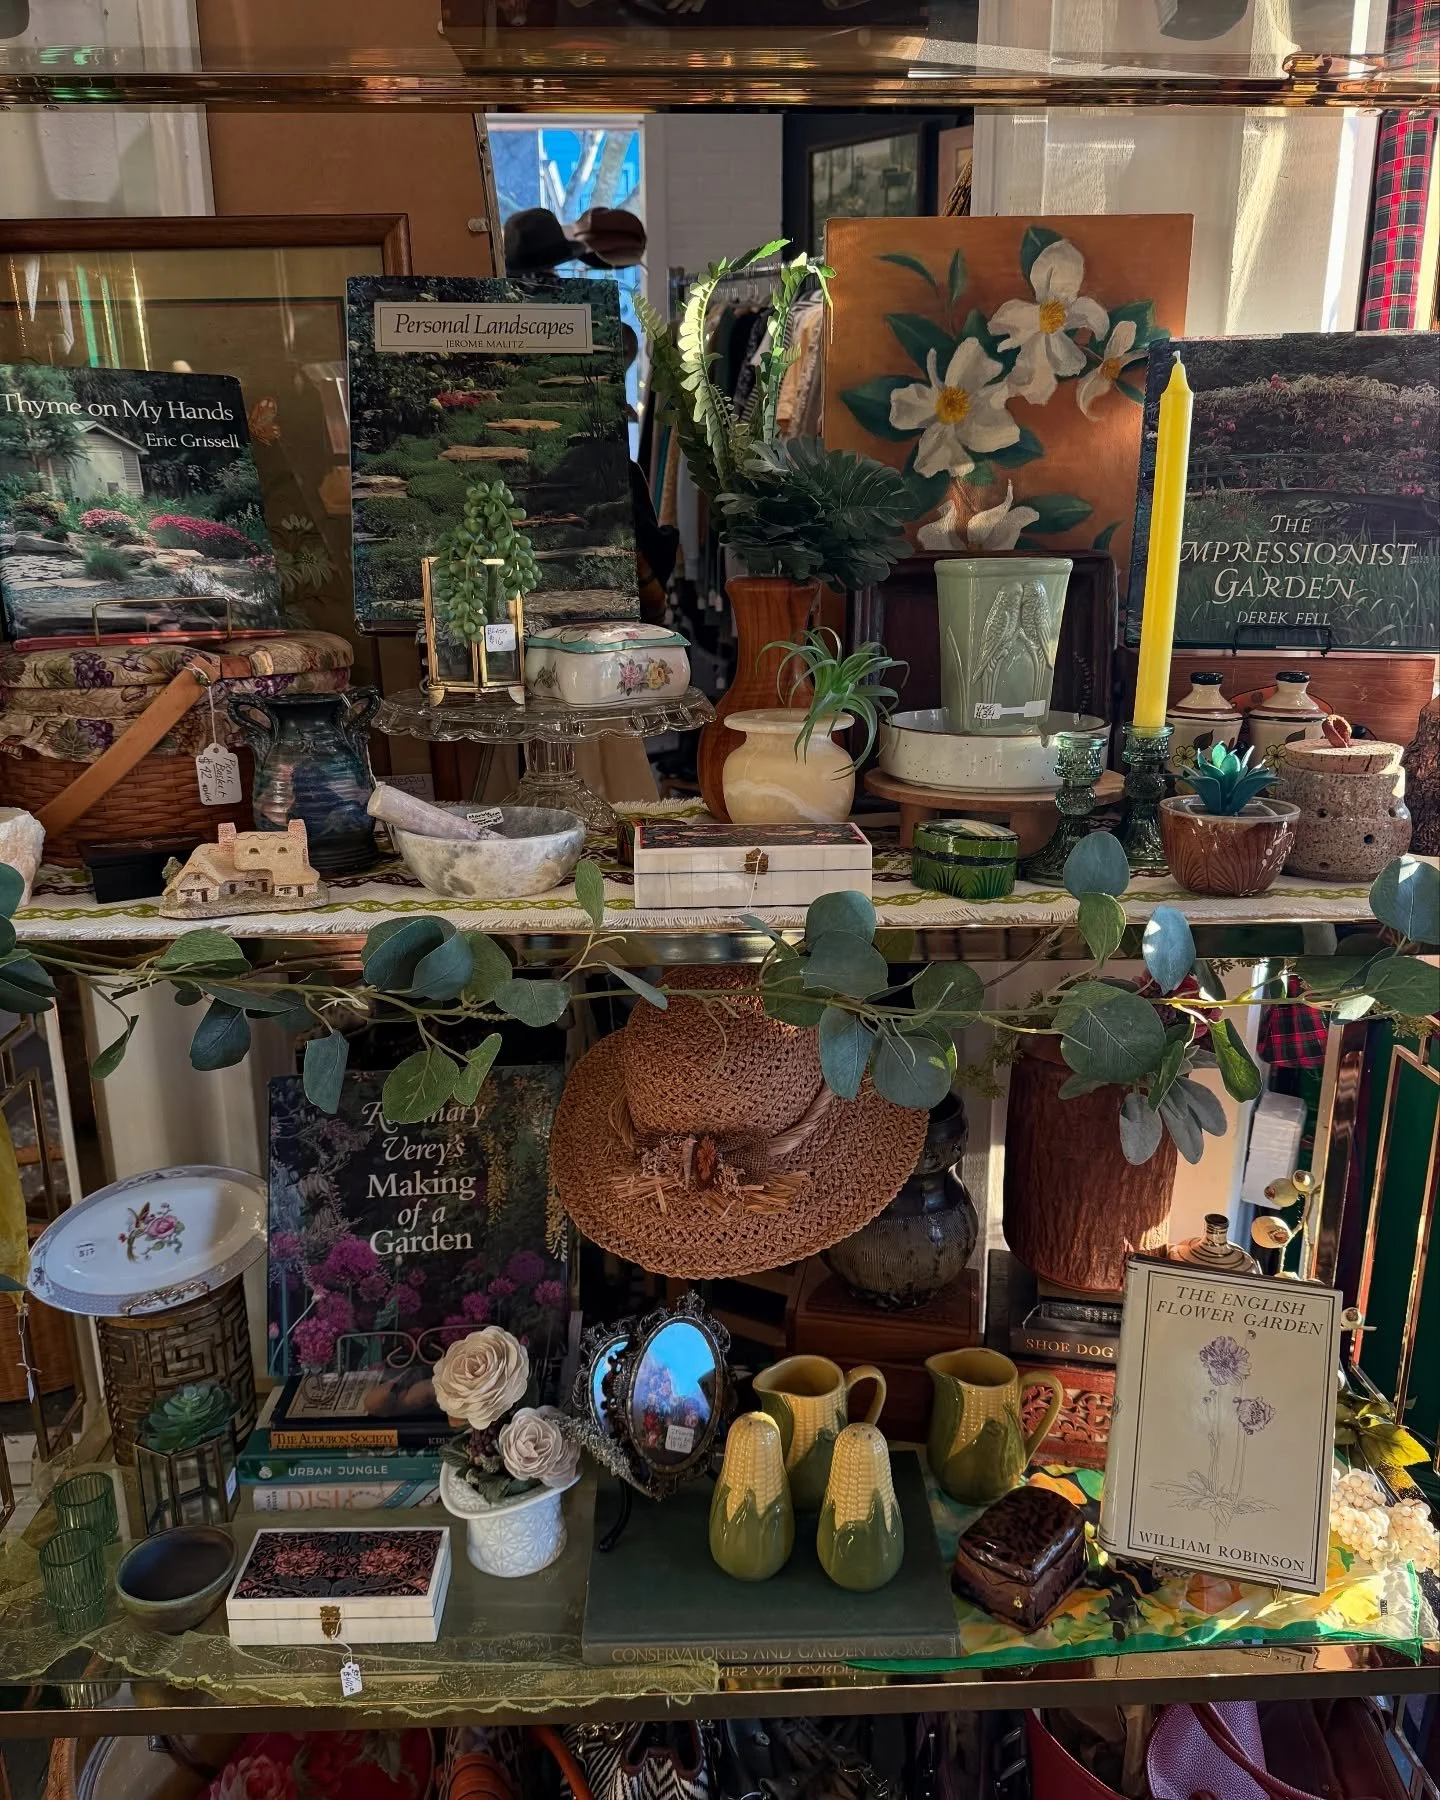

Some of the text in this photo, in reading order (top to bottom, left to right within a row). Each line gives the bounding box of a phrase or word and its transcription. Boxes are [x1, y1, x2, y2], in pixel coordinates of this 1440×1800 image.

[394, 313, 575, 339] Personal Landscapes
[445, 340, 525, 349] JEROME MALITZ
[0, 393, 234, 424] Thyme on My Hands
[145, 432, 240, 448] Eric Grissell
[1269, 515, 1311, 533] THE
[1181, 541, 1417, 566] MPRESSIONIST
[1212, 568, 1357, 605] GARDEN
[1236, 611, 1331, 626] DEREK FELL
[215, 762, 229, 797] Basket
[382, 1134, 465, 1166] Verey's
[366, 1169, 477, 1201] Making
[397, 1198, 447, 1233] of a
[369, 1226, 474, 1255] Garden
[1177, 1286, 1306, 1316] THE ENGLISH
[1156, 1300, 1324, 1336] FLOWER GARDEN
[1026, 1338, 1114, 1358] SHOE DOG
[274, 1430, 394, 1445] THE AUDUBON SOCIETY
[288, 1465, 389, 1476] URBAN JUNGLE
[1139, 1530, 1305, 1572] WILLIAM ROBINSON
[611, 1646, 748, 1662] CONSERVATORIES
[753, 1647, 791, 1660] AND
[799, 1646, 867, 1659] GARDEN
